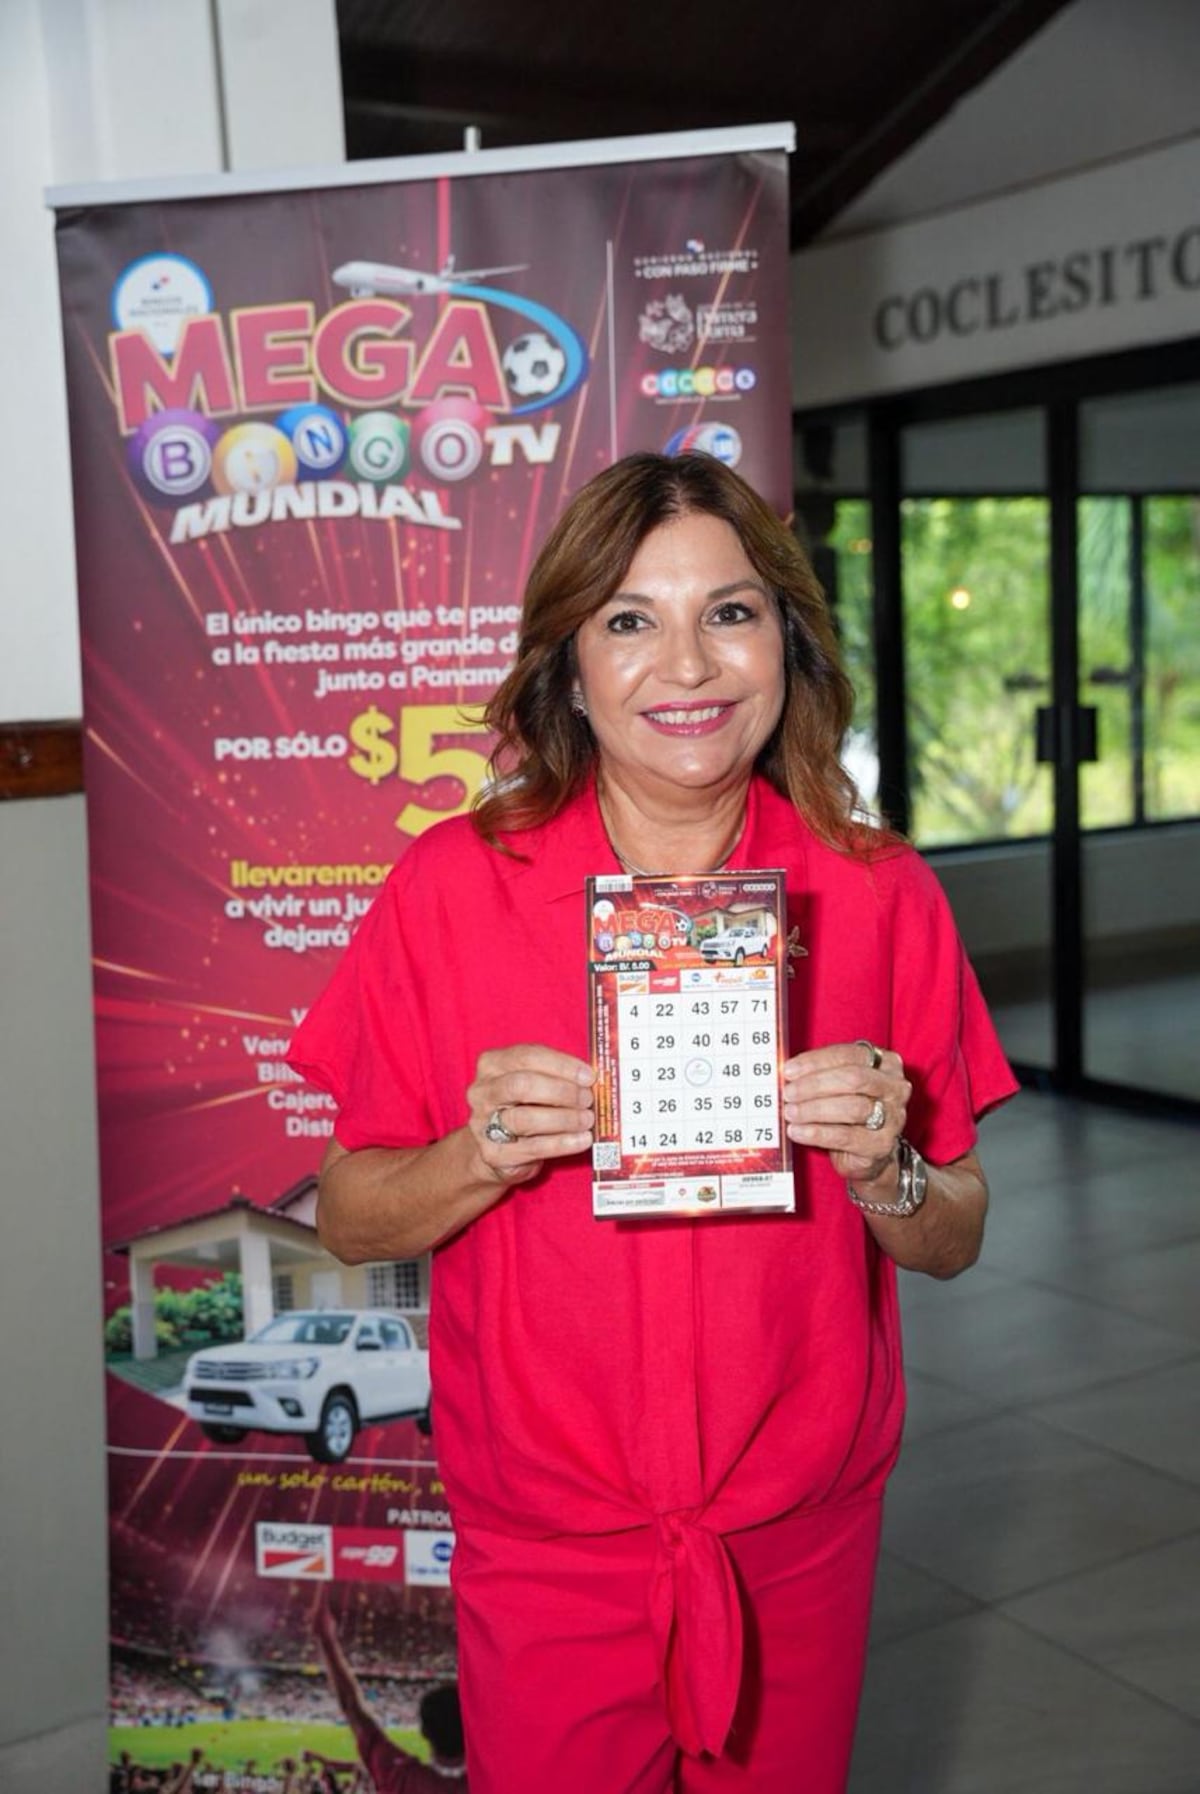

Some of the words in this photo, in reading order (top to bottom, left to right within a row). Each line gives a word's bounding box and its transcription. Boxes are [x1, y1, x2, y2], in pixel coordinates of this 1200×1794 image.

[873, 222, 1200, 352] COCLESITO
[109, 299, 511, 437] MEGA
[485, 423, 560, 464] TV
[169, 481, 462, 545] MUNDIAL
[206, 613, 229, 635] El
[234, 610, 302, 634] único
[306, 608, 379, 636] bingo
[383, 608, 431, 632] que
[436, 605, 465, 627] te
[470, 605, 524, 630] pue
[212, 650, 230, 666] a
[235, 644, 261, 665] la
[265, 641, 340, 664] fiesta
[344, 638, 397, 661] más
[401, 632, 496, 664] grande
[314, 669, 385, 698] junto
[388, 673, 408, 690] a
[215, 737, 271, 761] POR
[275, 731, 349, 759] SÓLO
[349, 703, 493, 839] $5
[225, 901, 245, 919] a
[248, 894, 305, 918] vivir
[309, 898, 341, 917] un
[264, 922, 350, 953] dejará
[593, 909, 678, 937] MEGA
[630, 1006, 639, 1017] 4
[656, 1004, 674, 1017] 22
[692, 1002, 710, 1015] 43
[721, 1001, 739, 1014] 57
[752, 1000, 768, 1012] 71
[631, 1038, 640, 1051] 6
[657, 1036, 675, 1049] 29
[693, 1034, 711, 1047] 40
[722, 1033, 740, 1046] 46
[753, 1032, 771, 1045] 68
[632, 1069, 641, 1082] 9
[658, 1068, 676, 1081] 23
[723, 1064, 741, 1077] 48
[754, 1063, 772, 1076] 69
[633, 1101, 642, 1114] 3
[659, 1099, 677, 1113] 26
[695, 1098, 713, 1111] 35
[724, 1096, 742, 1110] 59
[754, 1095, 772, 1108] 65
[631, 1135, 647, 1148] 14
[660, 1134, 678, 1147] 24
[696, 1131, 713, 1144] 42
[725, 1130, 743, 1143] 58
[756, 1128, 773, 1142] 75
[261, 1529, 325, 1549] Budget
